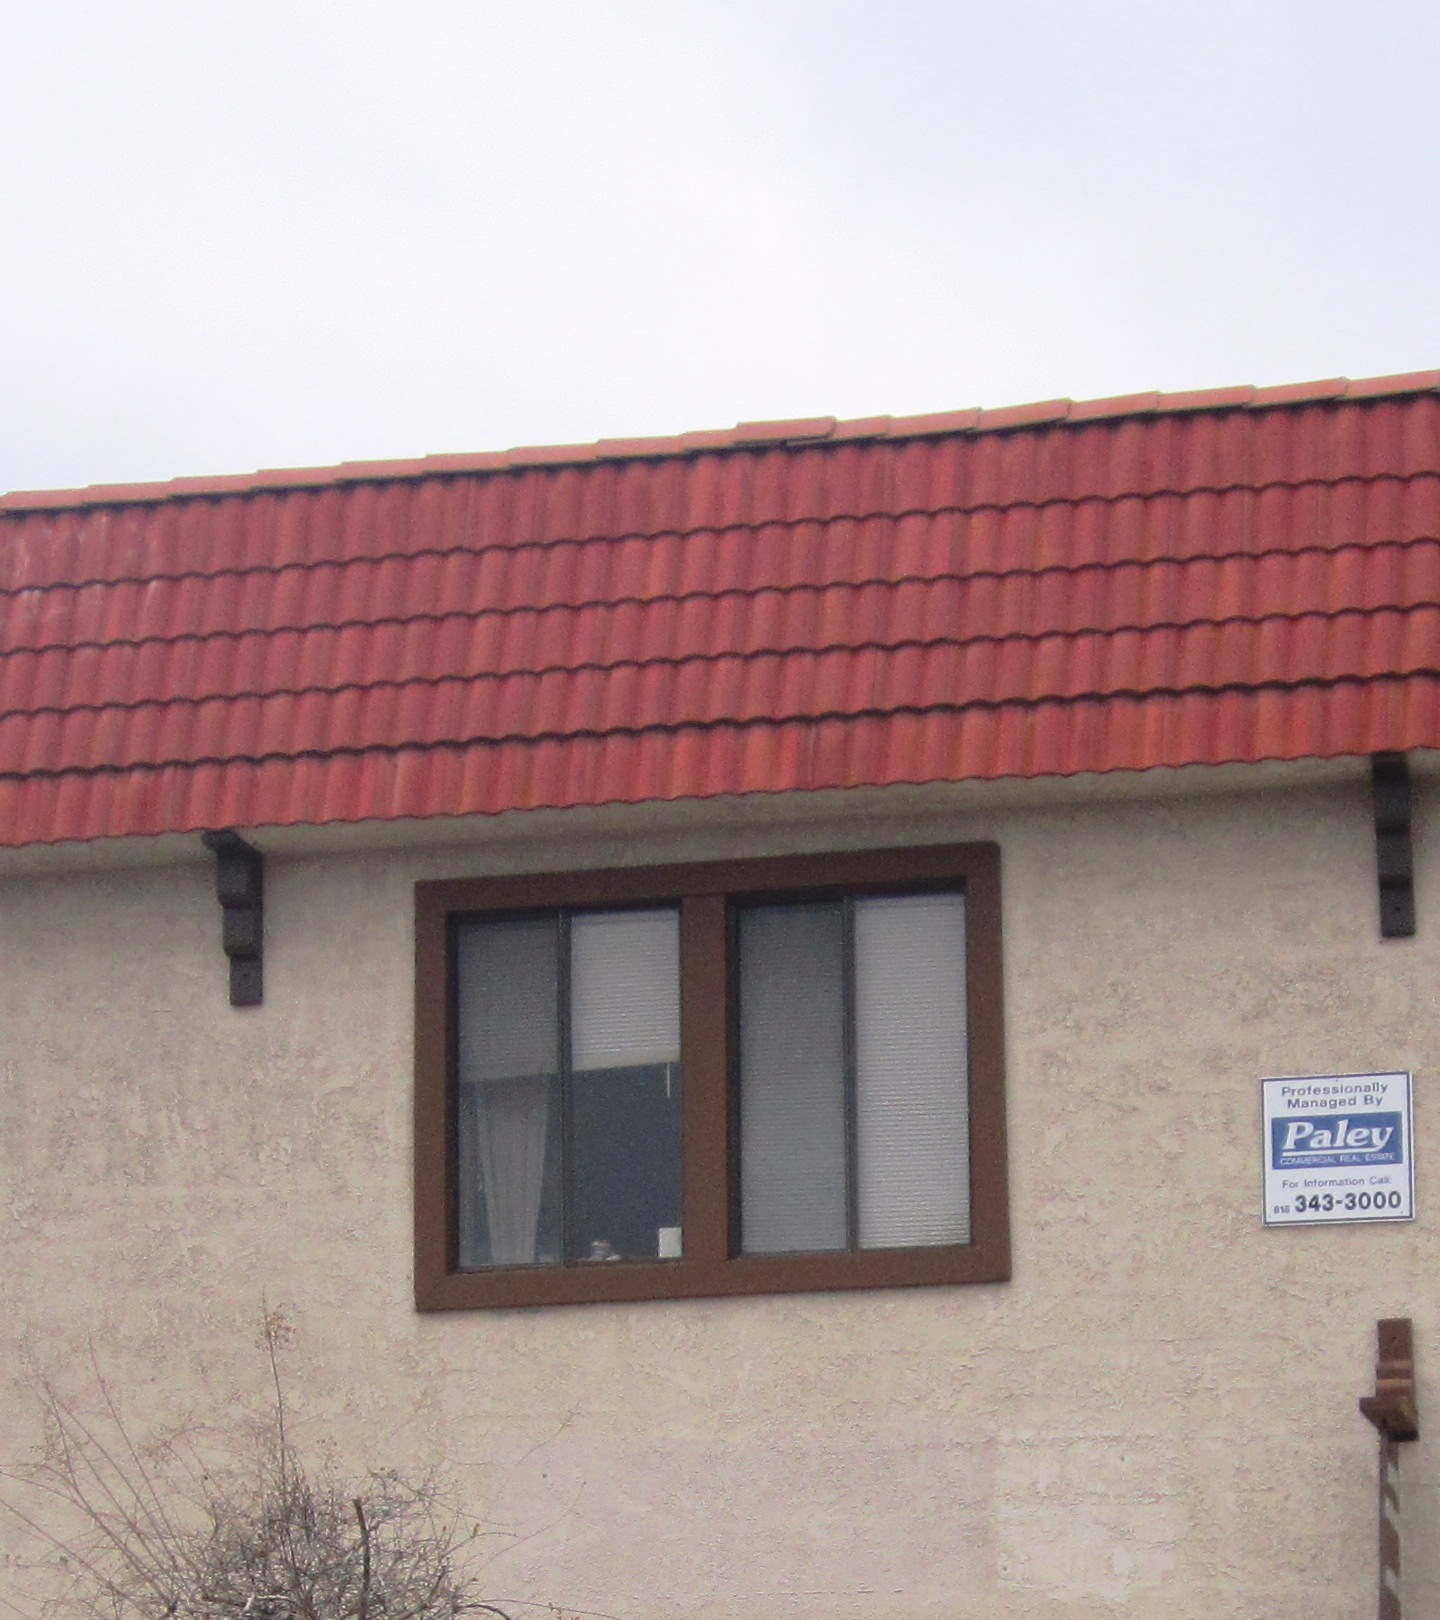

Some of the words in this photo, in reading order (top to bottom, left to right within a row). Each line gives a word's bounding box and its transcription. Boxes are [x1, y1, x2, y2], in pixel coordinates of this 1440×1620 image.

[1281, 1082, 1388, 1097] Professionally
[1287, 1097, 1357, 1109] Managed
[1364, 1095, 1383, 1106] By
[1282, 1119, 1394, 1155] Paley
[1280, 1155, 1337, 1165] COMMERCIAL
[1339, 1154, 1361, 1162] REAL
[1365, 1152, 1395, 1161] ESTATE
[1282, 1178, 1299, 1188] For
[1304, 1177, 1365, 1188] Information
[1295, 1191, 1402, 1213] 343-3000
